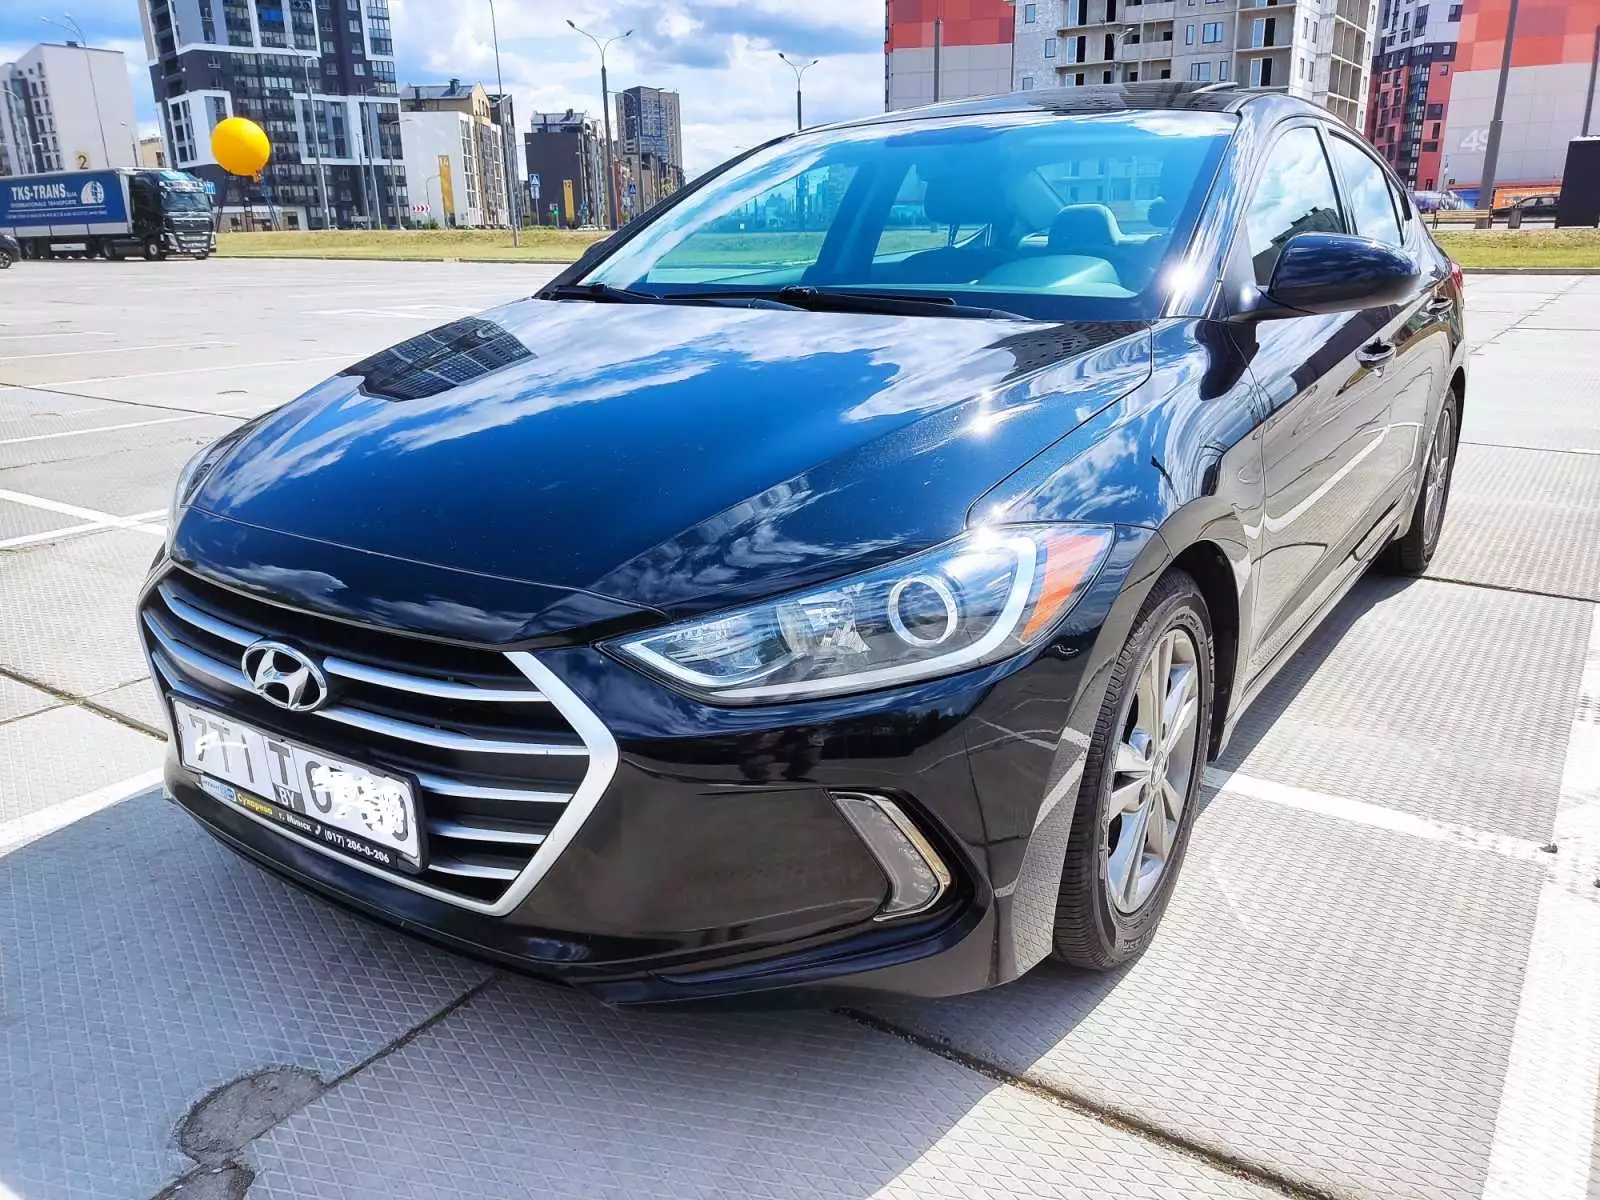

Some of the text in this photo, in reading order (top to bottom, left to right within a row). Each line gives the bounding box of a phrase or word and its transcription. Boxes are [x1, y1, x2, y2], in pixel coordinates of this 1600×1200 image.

[77, 155, 88, 169] 2
[11, 183, 66, 200] TKS-TRANS
[279, 786, 297, 810] BY
[324, 829, 345, 848] (017)
[346, 838, 390, 864] 206-0-206
